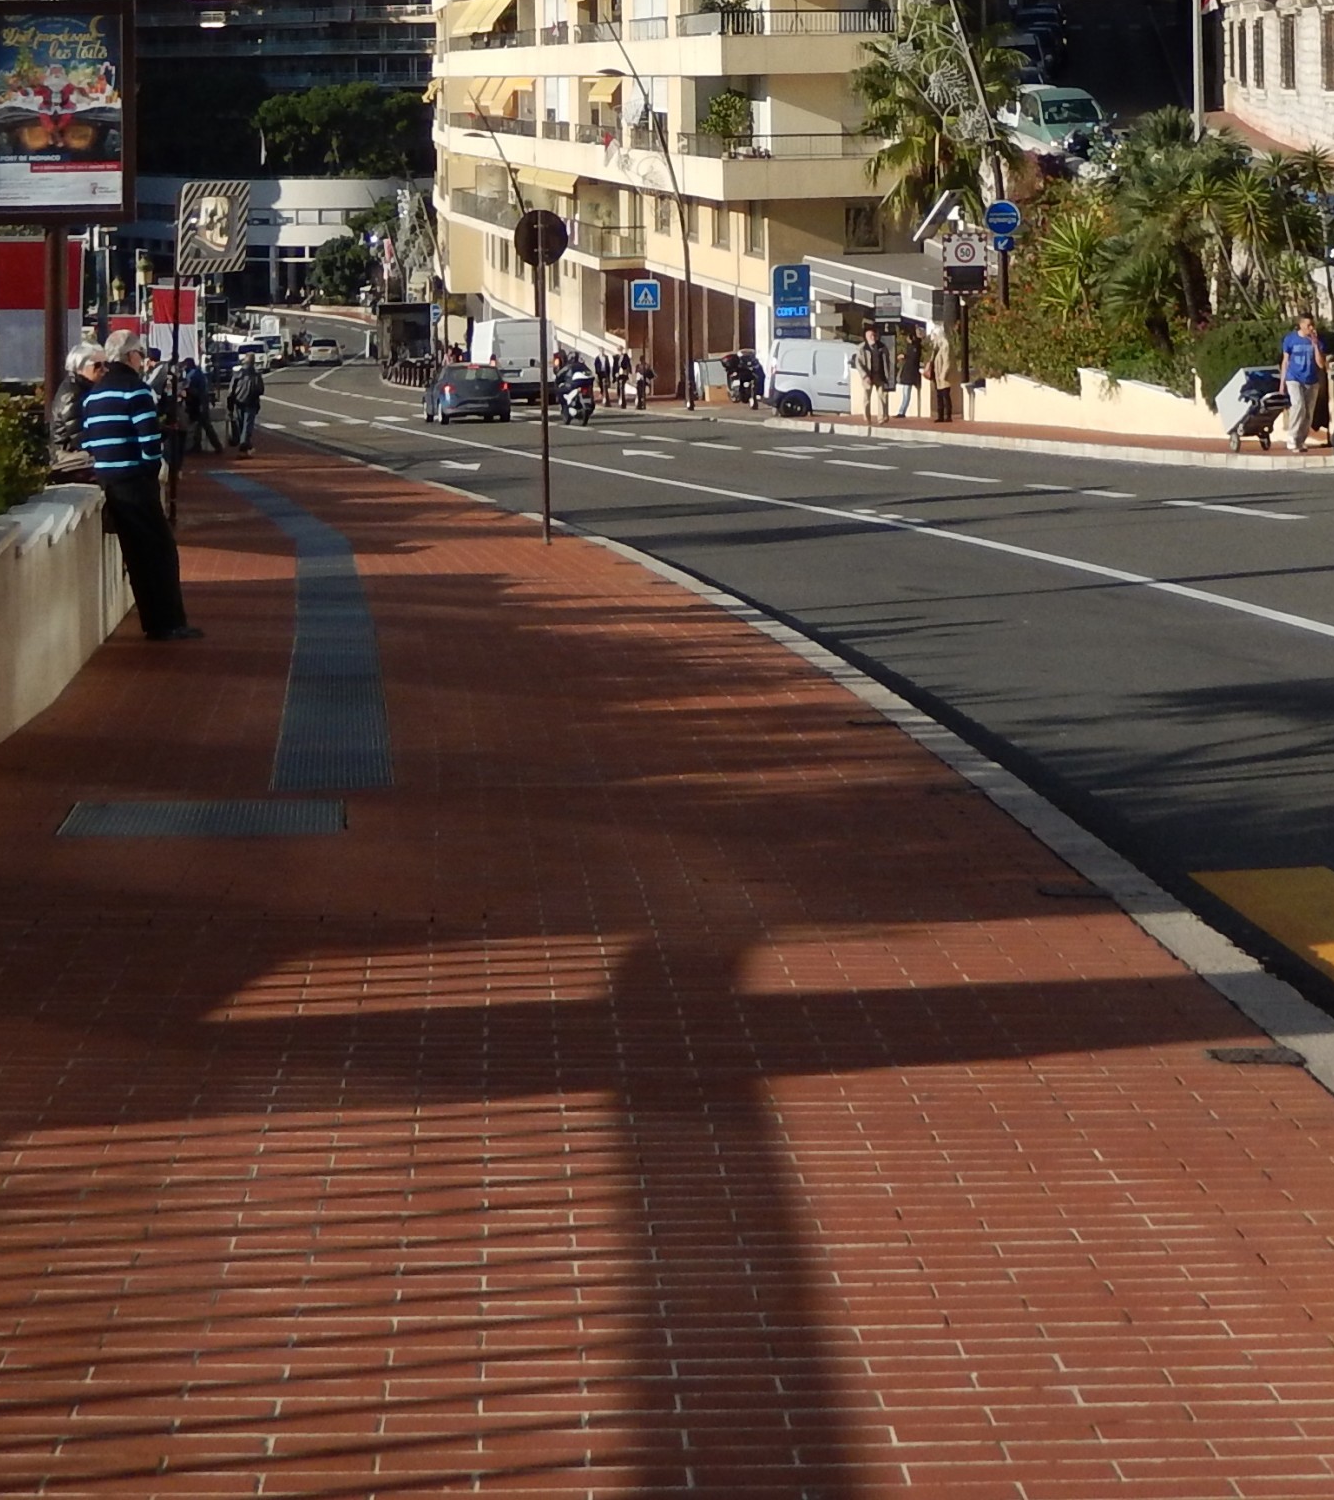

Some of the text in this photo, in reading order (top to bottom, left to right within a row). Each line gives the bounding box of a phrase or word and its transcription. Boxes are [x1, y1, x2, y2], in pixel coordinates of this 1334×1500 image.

[960, 247, 971, 258] 50
[783, 269, 798, 290] P
[776, 306, 809, 317] COMPLET
